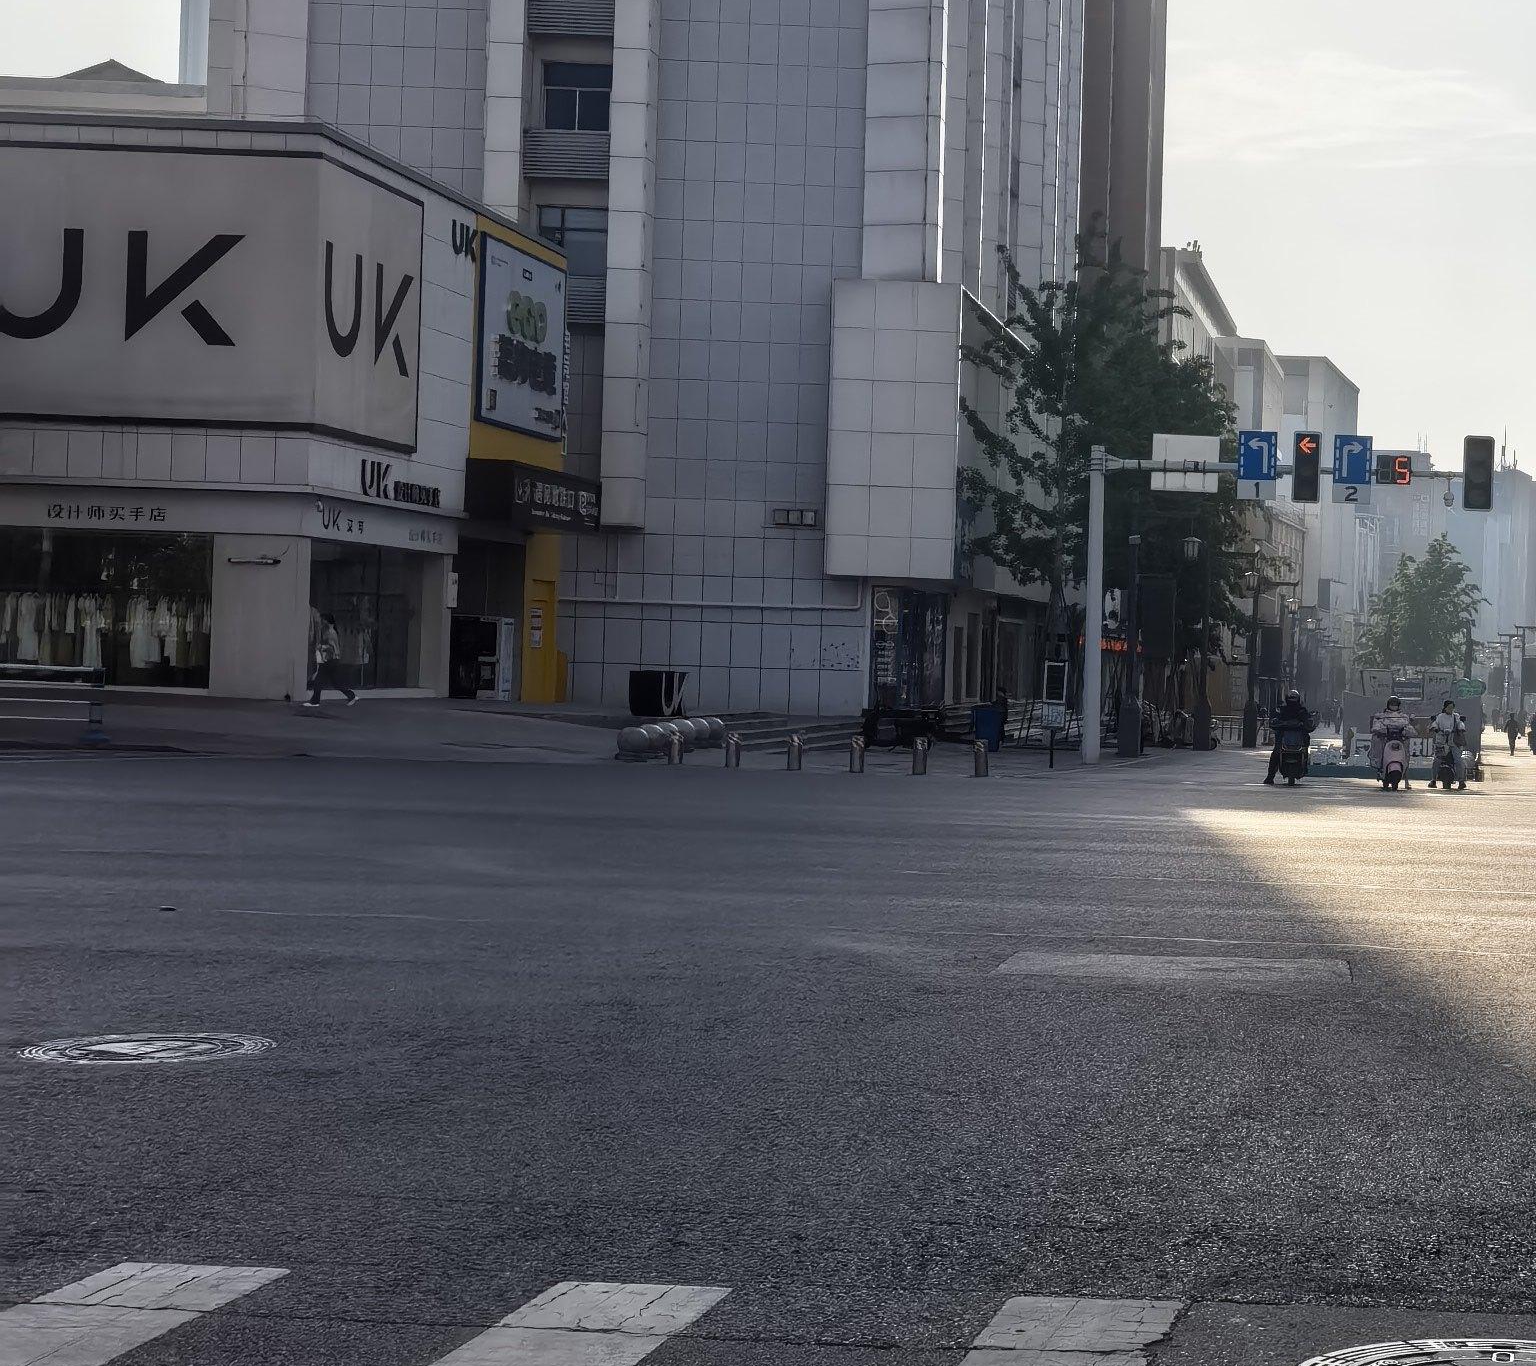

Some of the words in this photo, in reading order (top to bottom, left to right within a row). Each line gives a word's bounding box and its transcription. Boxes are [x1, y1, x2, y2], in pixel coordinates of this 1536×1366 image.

[451, 218, 478, 262] UK
[0, 228, 247, 346] UK
[324, 240, 415, 378] UK
[361, 458, 393, 500] UK
[1394, 457, 1410, 484] 5
[1254, 481, 1261, 499] 1
[1344, 485, 1359, 502] 2
[47, 503, 167, 522] 设计师买手店
[322, 506, 342, 531] UK
